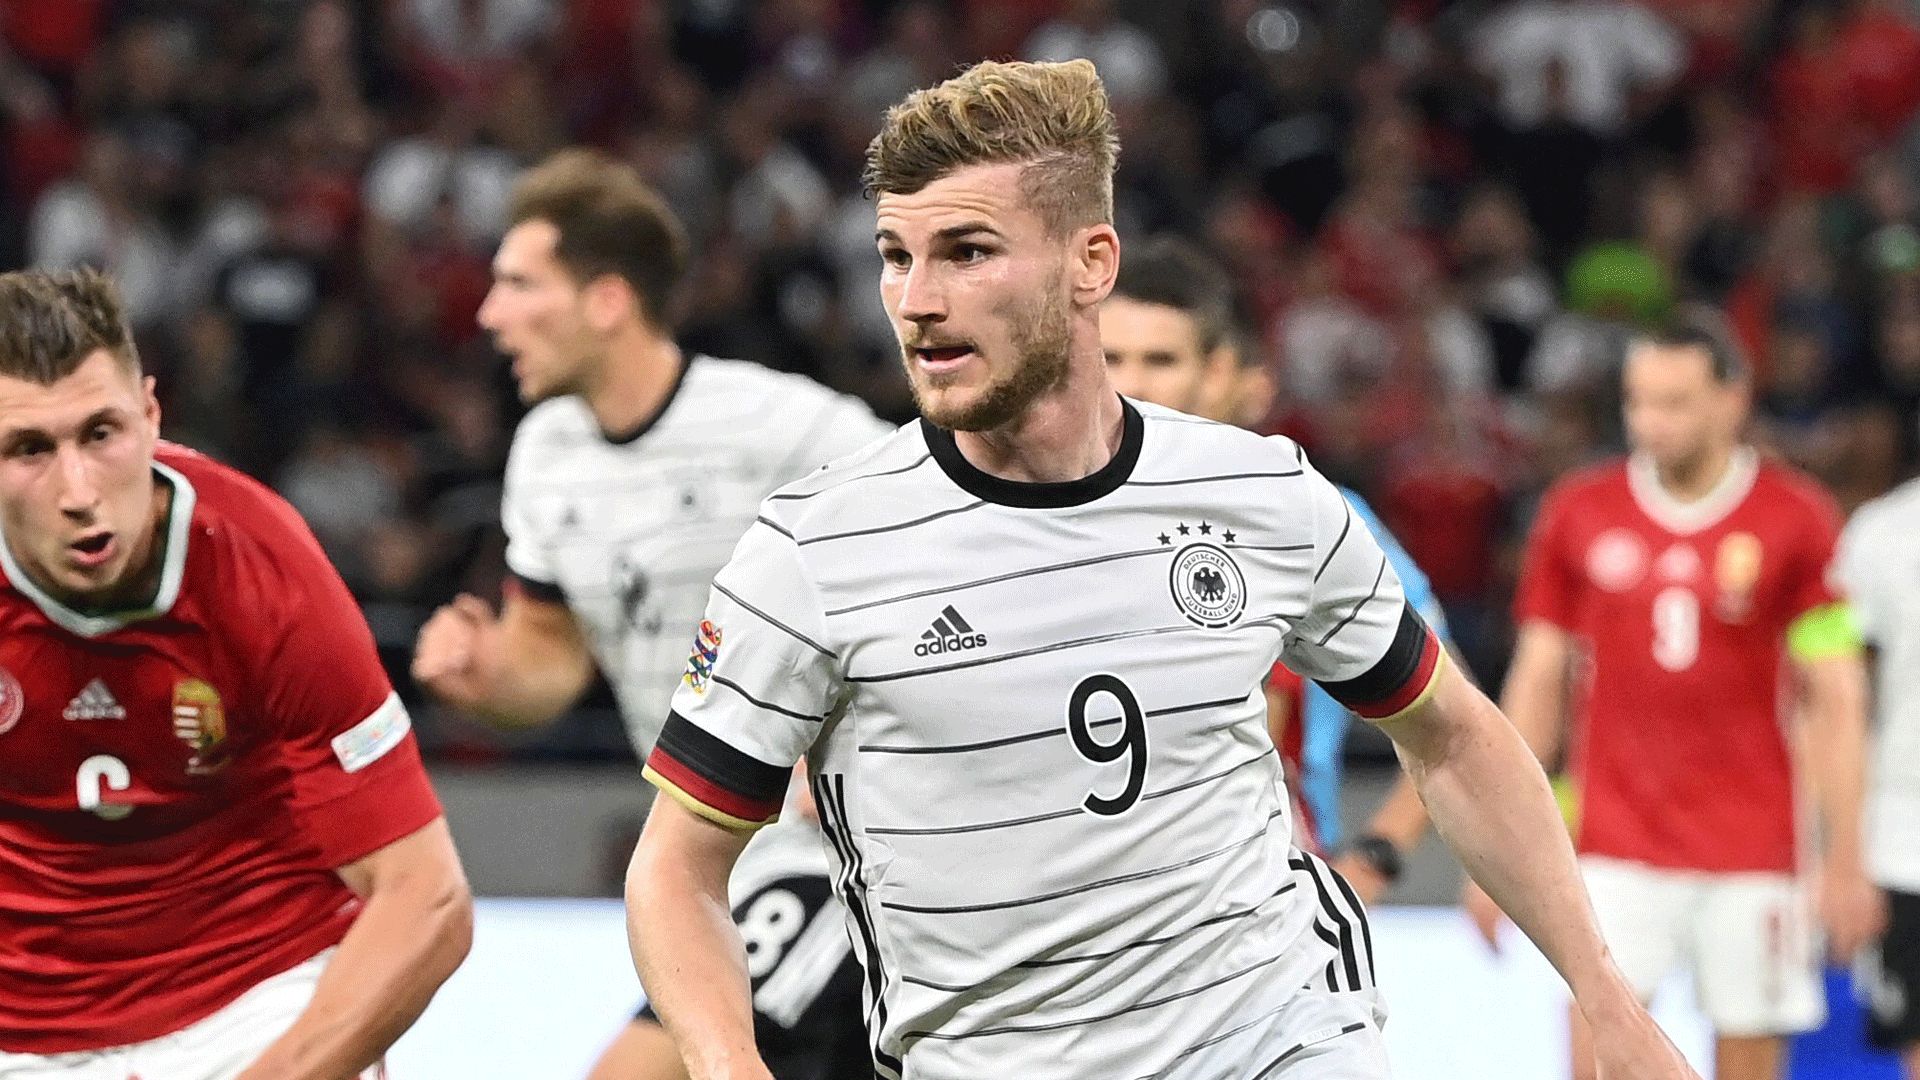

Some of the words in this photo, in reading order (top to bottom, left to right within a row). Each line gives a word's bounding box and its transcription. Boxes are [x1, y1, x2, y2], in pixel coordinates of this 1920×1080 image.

[1183, 553, 1225, 570] DEUTSCHER
[914, 633, 988, 656] adidas
[1068, 673, 1148, 816] 9
